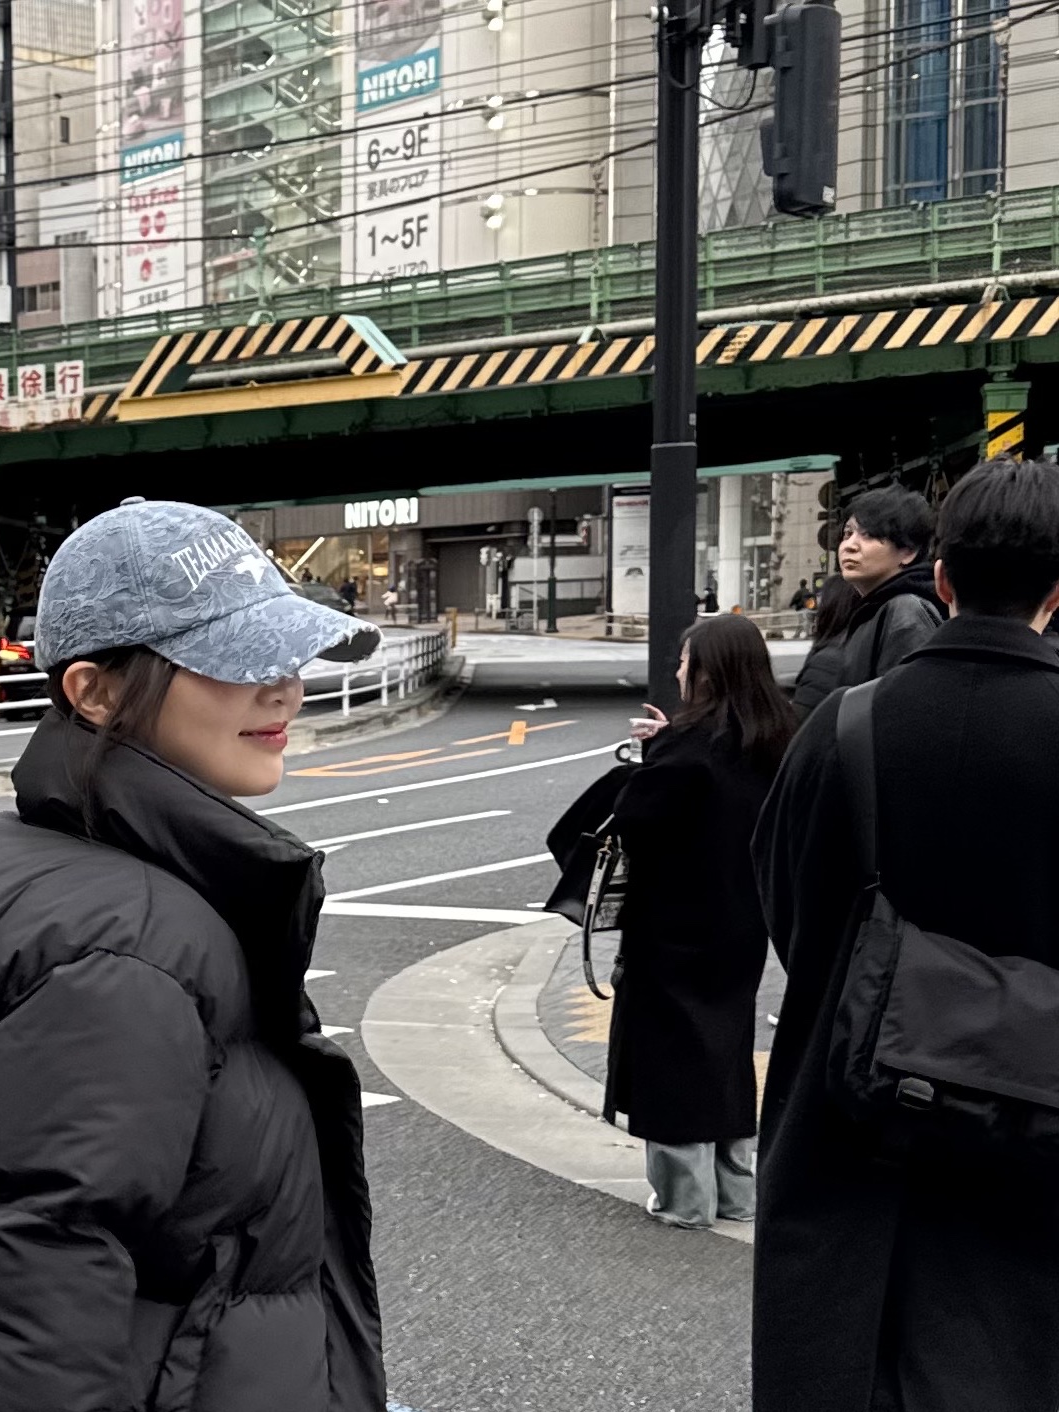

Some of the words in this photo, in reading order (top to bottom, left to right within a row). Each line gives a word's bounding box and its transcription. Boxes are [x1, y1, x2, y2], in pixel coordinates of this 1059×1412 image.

[362, 56, 436, 105] NITORI
[124, 139, 181, 179] NITORI
[344, 498, 419, 530] NITORI
